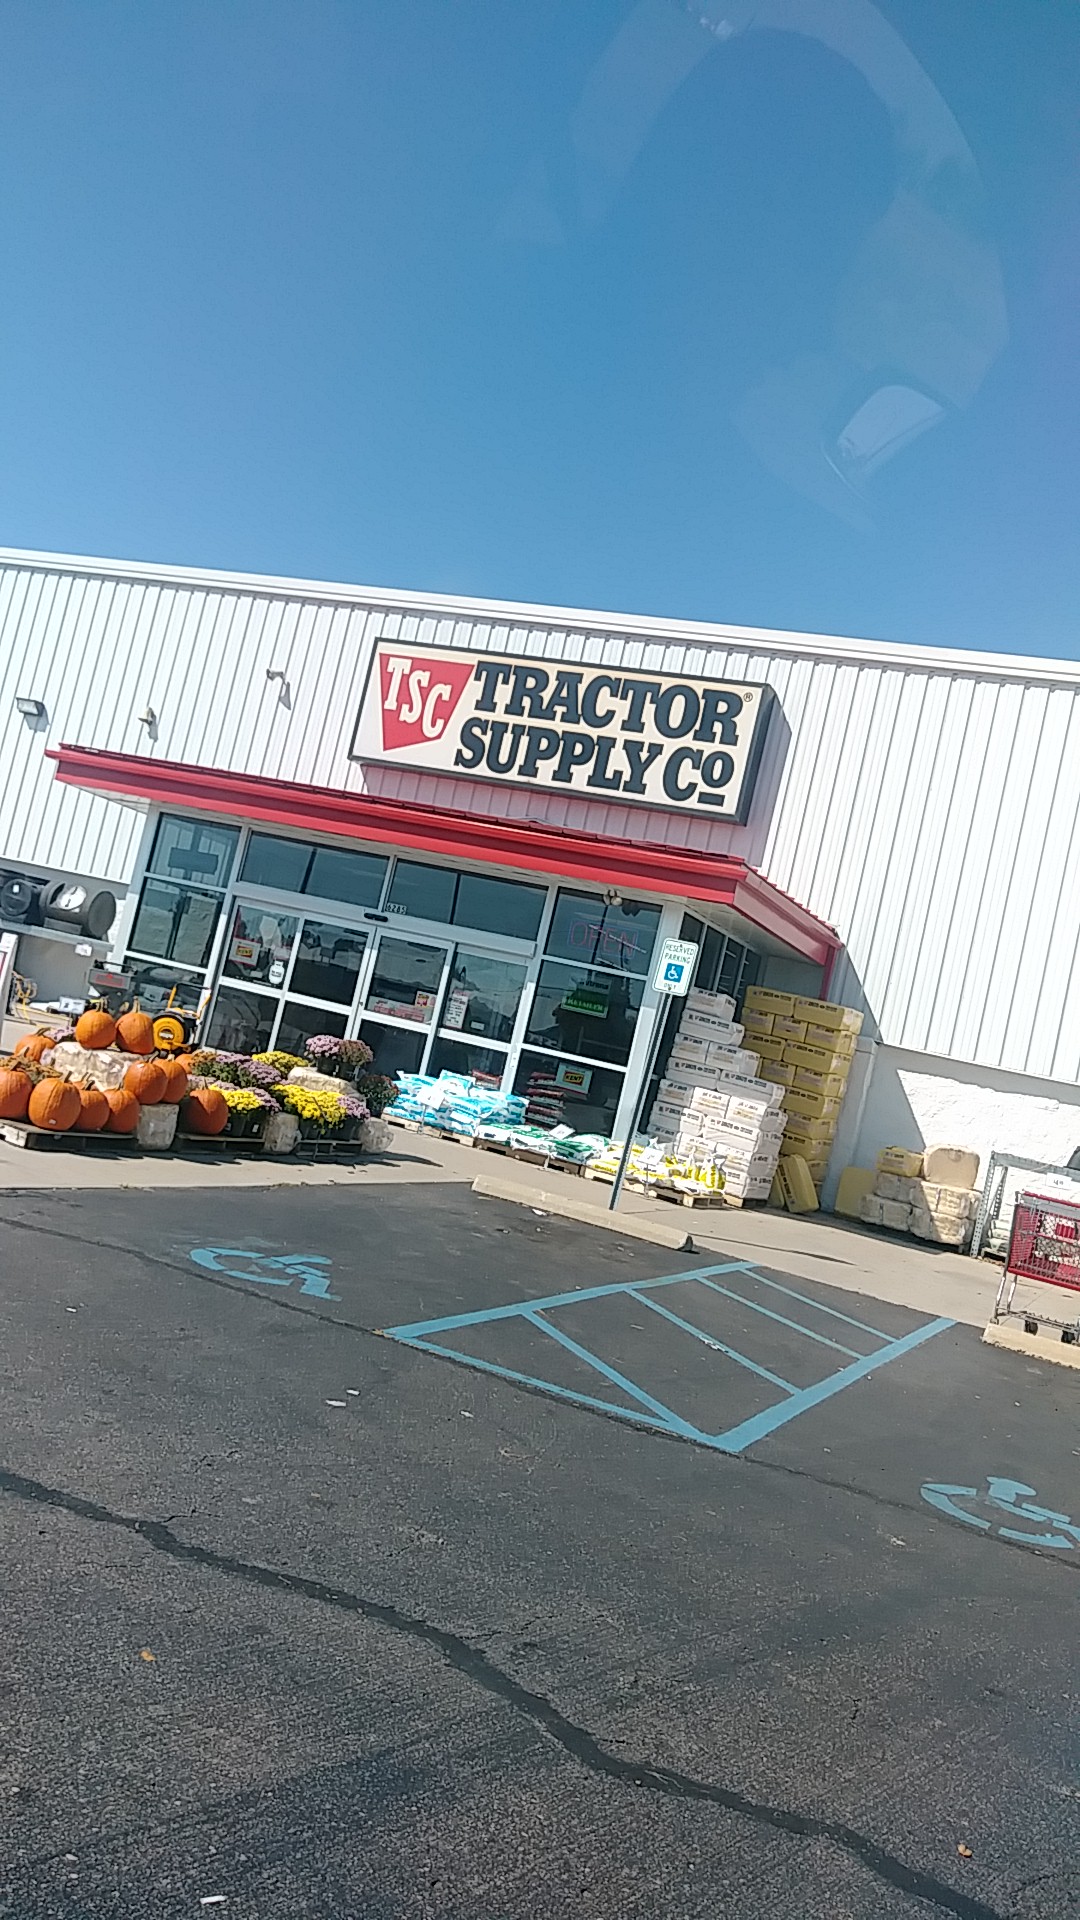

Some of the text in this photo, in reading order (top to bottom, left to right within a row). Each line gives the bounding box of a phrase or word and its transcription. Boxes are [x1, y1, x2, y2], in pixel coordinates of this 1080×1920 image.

[383, 657, 453, 739] TSC
[473, 659, 745, 746] TRACTOR
[453, 716, 664, 795] SUPPLY
[570, 921, 637, 957] OPEN
[664, 952, 691, 964] PARKING
[665, 943, 695, 955] RESERVED
